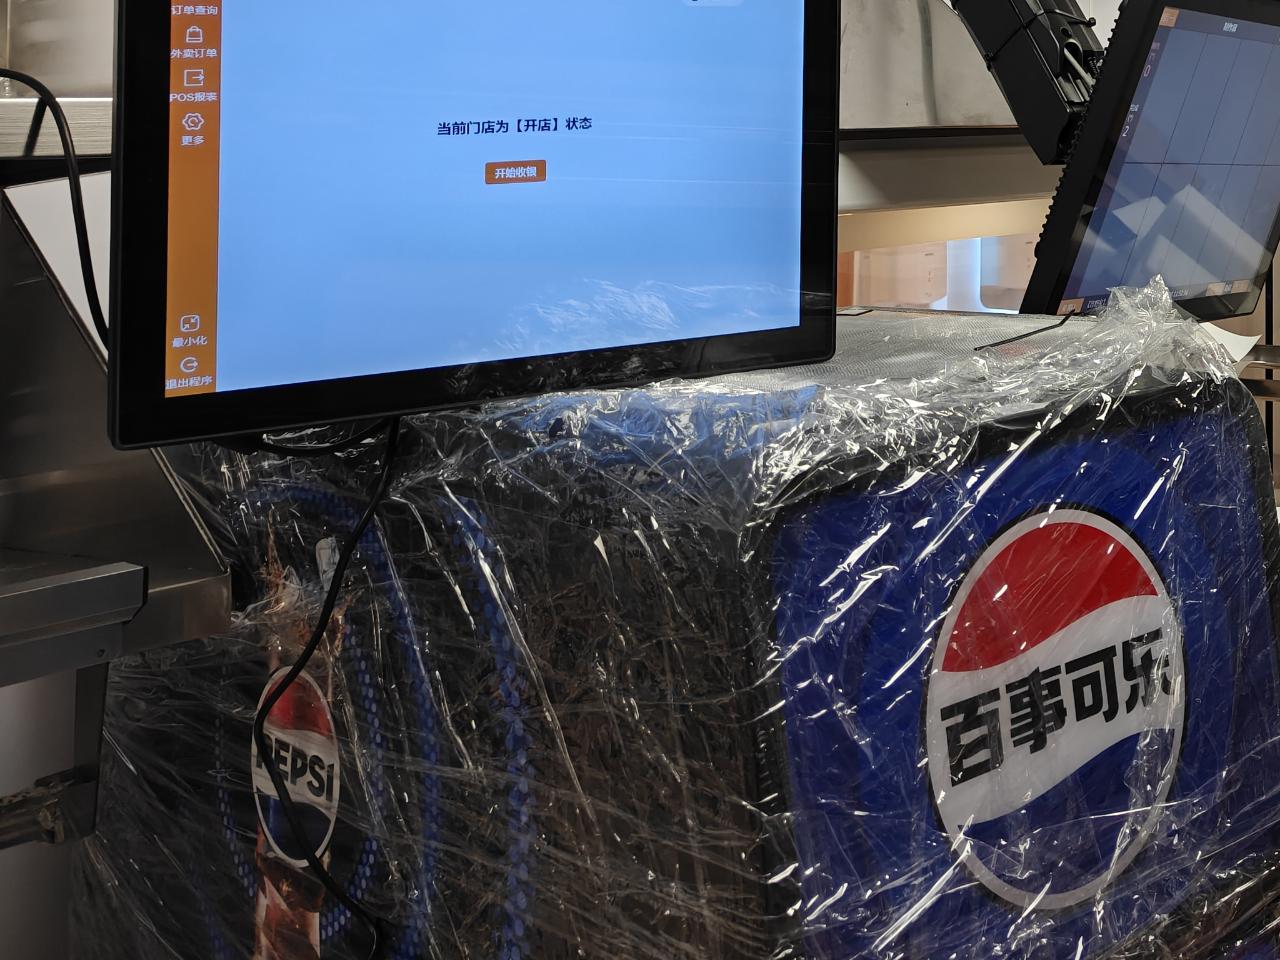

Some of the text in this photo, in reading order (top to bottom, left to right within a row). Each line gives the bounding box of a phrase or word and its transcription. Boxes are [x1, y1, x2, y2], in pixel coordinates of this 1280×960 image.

[170, 5, 218, 16] 订单查询
[170, 48, 217, 58] 外卖订单
[169, 91, 217, 103] POS报表
[437, 117, 592, 136] 当前门店为【开店】状态
[181, 135, 205, 146] 更多
[494, 165, 538, 179] 开始收银
[940, 627, 1175, 788] 百事可乐
